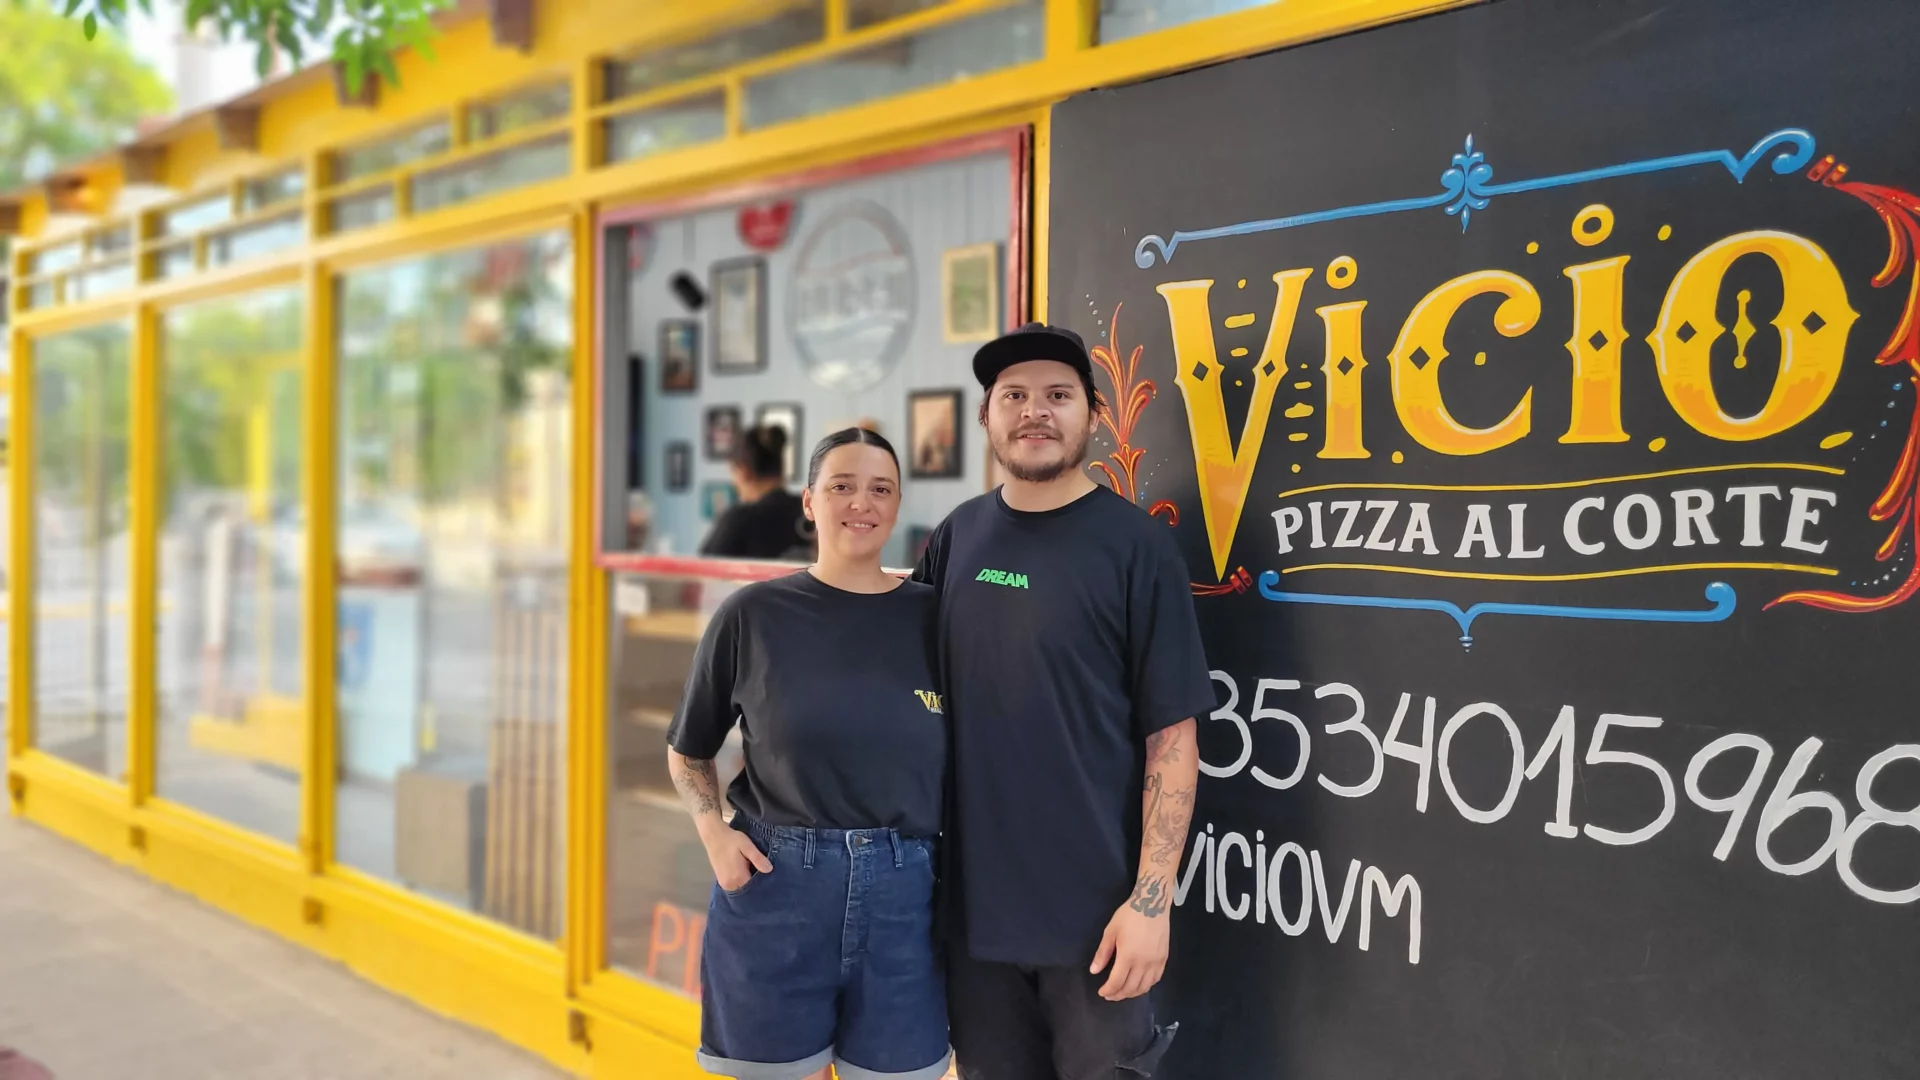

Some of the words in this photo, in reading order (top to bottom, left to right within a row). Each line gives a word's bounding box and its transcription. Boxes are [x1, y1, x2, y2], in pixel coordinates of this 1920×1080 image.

[1270, 500, 1440, 555] PIZZA
[1453, 504, 1546, 560] AL
[1562, 485, 1838, 555] CORTE
[975, 568, 1029, 590] DREAM
[1198, 669, 1920, 904] 3534015968
